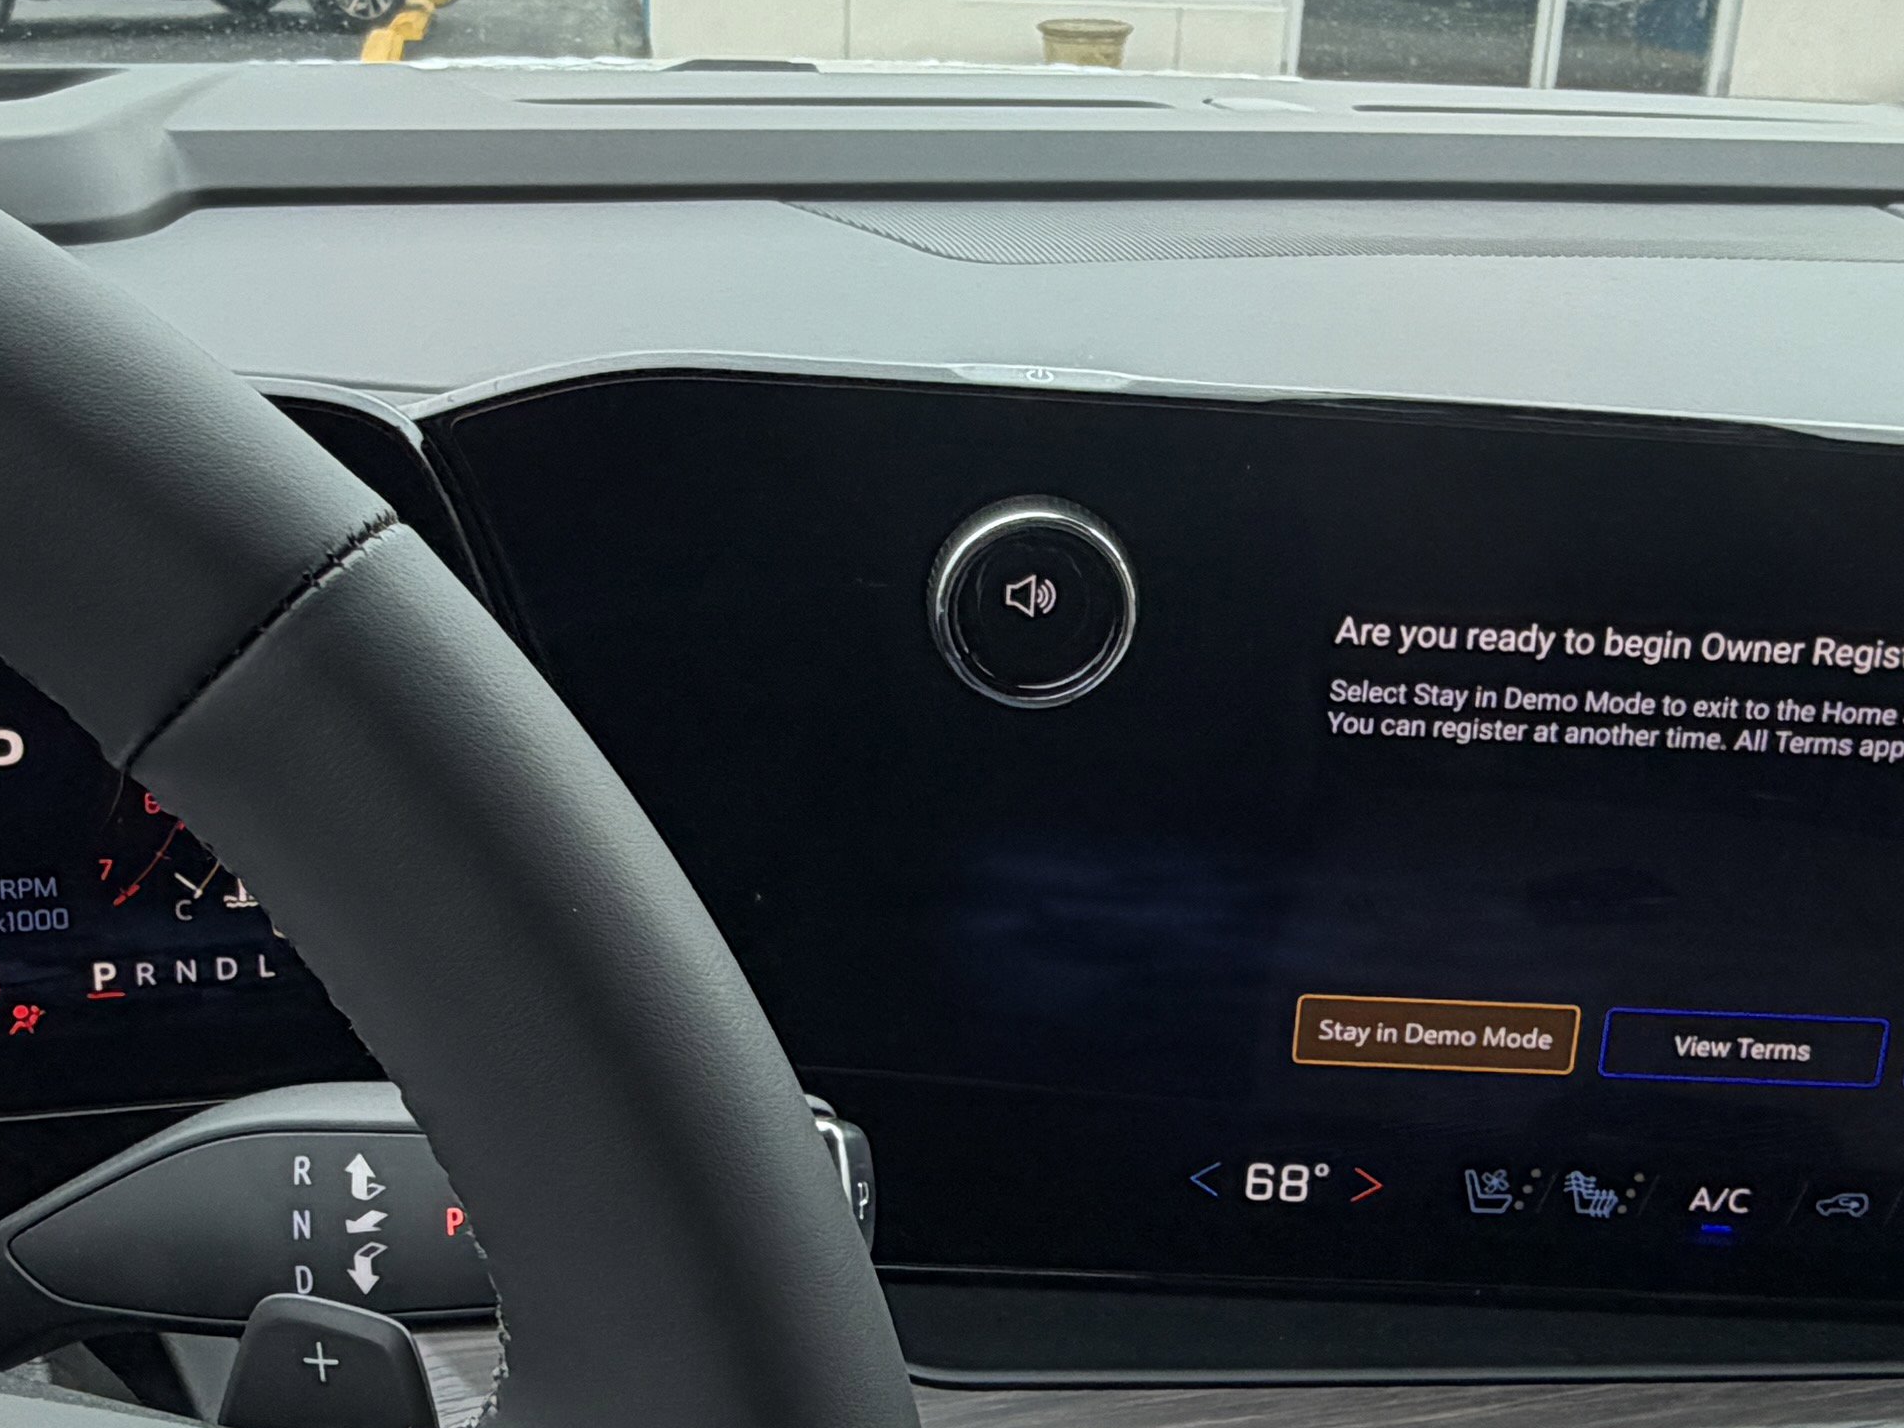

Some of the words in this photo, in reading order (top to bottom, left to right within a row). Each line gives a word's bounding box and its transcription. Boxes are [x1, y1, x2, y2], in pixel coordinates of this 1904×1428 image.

[1334, 615, 1391, 647] Are
[1397, 624, 1458, 654] you
[1466, 622, 1557, 661] ready
[1563, 628, 1596, 656] to
[1603, 626, 1692, 666] begin
[1701, 632, 1806, 664] Owner
[1329, 678, 1408, 705] Select
[1413, 682, 1469, 713] Stay
[1474, 685, 1498, 709] in
[1504, 686, 1579, 712] Demo
[1584, 690, 1656, 716] Mode
[1662, 695, 1688, 717] to
[1692, 696, 1740, 719] exit
[1745, 699, 1771, 720] to
[1776, 698, 1817, 723] the
[1821, 701, 1898, 726] Home
[1327, 710, 1375, 735] You
[1380, 718, 1426, 737] can
[1432, 717, 1529, 745] register
[1533, 722, 1560, 743] at
[1564, 722, 1661, 747] another
[1666, 726, 1727, 751] time.
[1733, 728, 1769, 752] All
[1775, 730, 1854, 756] Terms
[98, 858, 113, 881] 7
[0, 876, 58, 900] RPM
[175, 899, 193, 921] C
[93, 962, 117, 992] P
[136, 962, 157, 986] R
[175, 959, 197, 984] N
[216, 956, 238, 981] D
[258, 954, 276, 978] L
[1318, 1019, 1371, 1048] Stay
[1376, 1022, 1398, 1044] in
[1404, 1022, 1477, 1047] Demo
[1482, 1026, 1553, 1050] Mode
[1674, 1035, 1732, 1058] View
[1737, 1037, 1811, 1062] Terms
[293, 1155, 312, 1186] R
[1688, 1186, 1751, 1214] A/C
[292, 1209, 311, 1240] N
[446, 1207, 464, 1236] P
[295, 1266, 314, 1295] D
